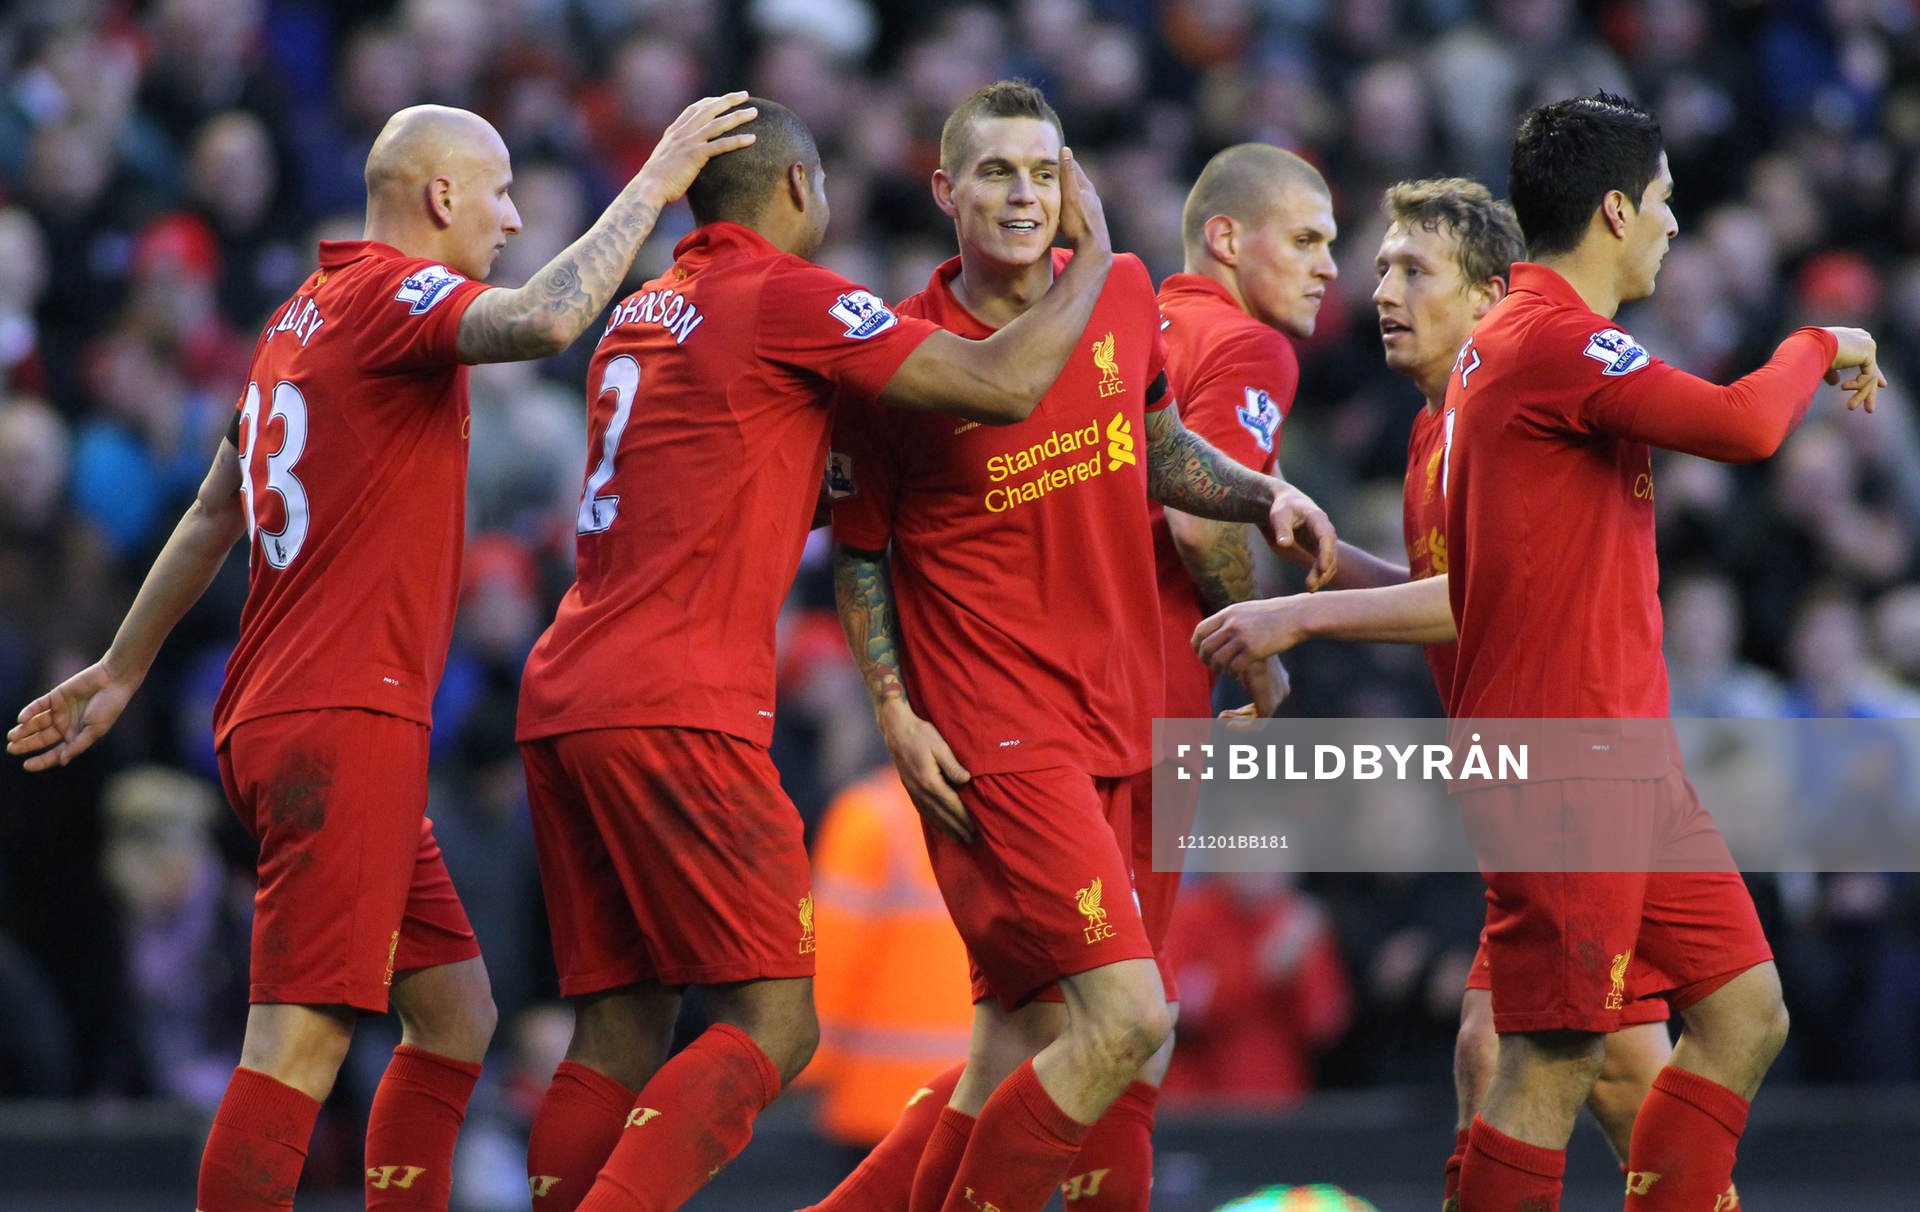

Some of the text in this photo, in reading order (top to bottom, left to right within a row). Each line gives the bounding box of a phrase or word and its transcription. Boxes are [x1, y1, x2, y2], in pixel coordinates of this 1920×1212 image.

[594, 289, 704, 351] OHNSON
[576, 353, 641, 536] 2
[986, 419, 1100, 482] Standard
[984, 450, 1102, 513] Chartered
